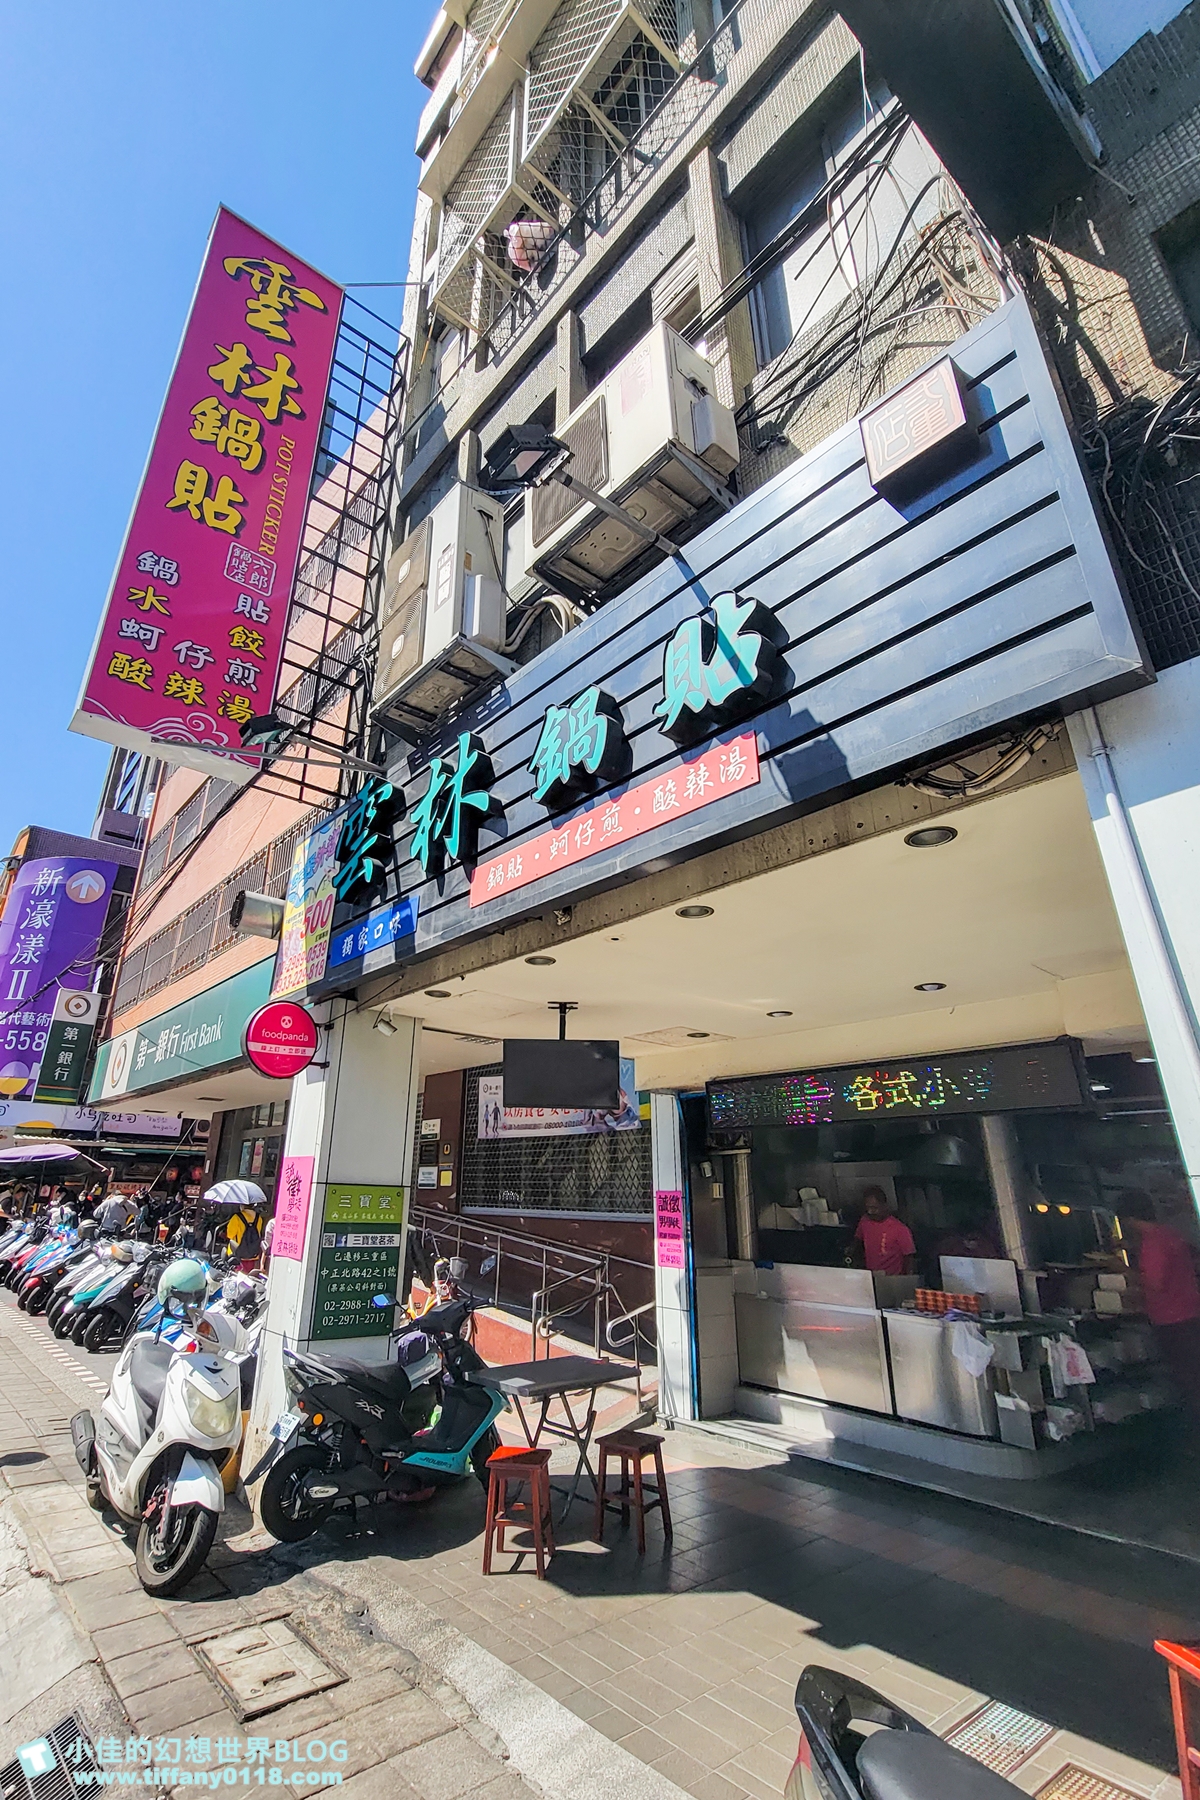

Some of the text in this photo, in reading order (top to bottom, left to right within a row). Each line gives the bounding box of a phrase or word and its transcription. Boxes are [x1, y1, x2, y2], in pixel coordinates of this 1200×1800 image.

[167, 256, 327, 536] 雲林鍋貼
[259, 473, 289, 556] STICKER
[332, 590, 764, 903] 雲林鍋貼
[341, 911, 402, 957] 獨家口味
[54, 1026, 79, 1081] 第一銀行
[135, 1023, 182, 1072] 第一銀行
[179, 1015, 224, 1056] First Bank
[261, 1028, 309, 1042] foodpanda
[338, 1194, 392, 1210] 三寶堂
[321, 1265, 397, 1280] 中正北路42之1號
[322, 1313, 385, 1326] 02-2971-2717
